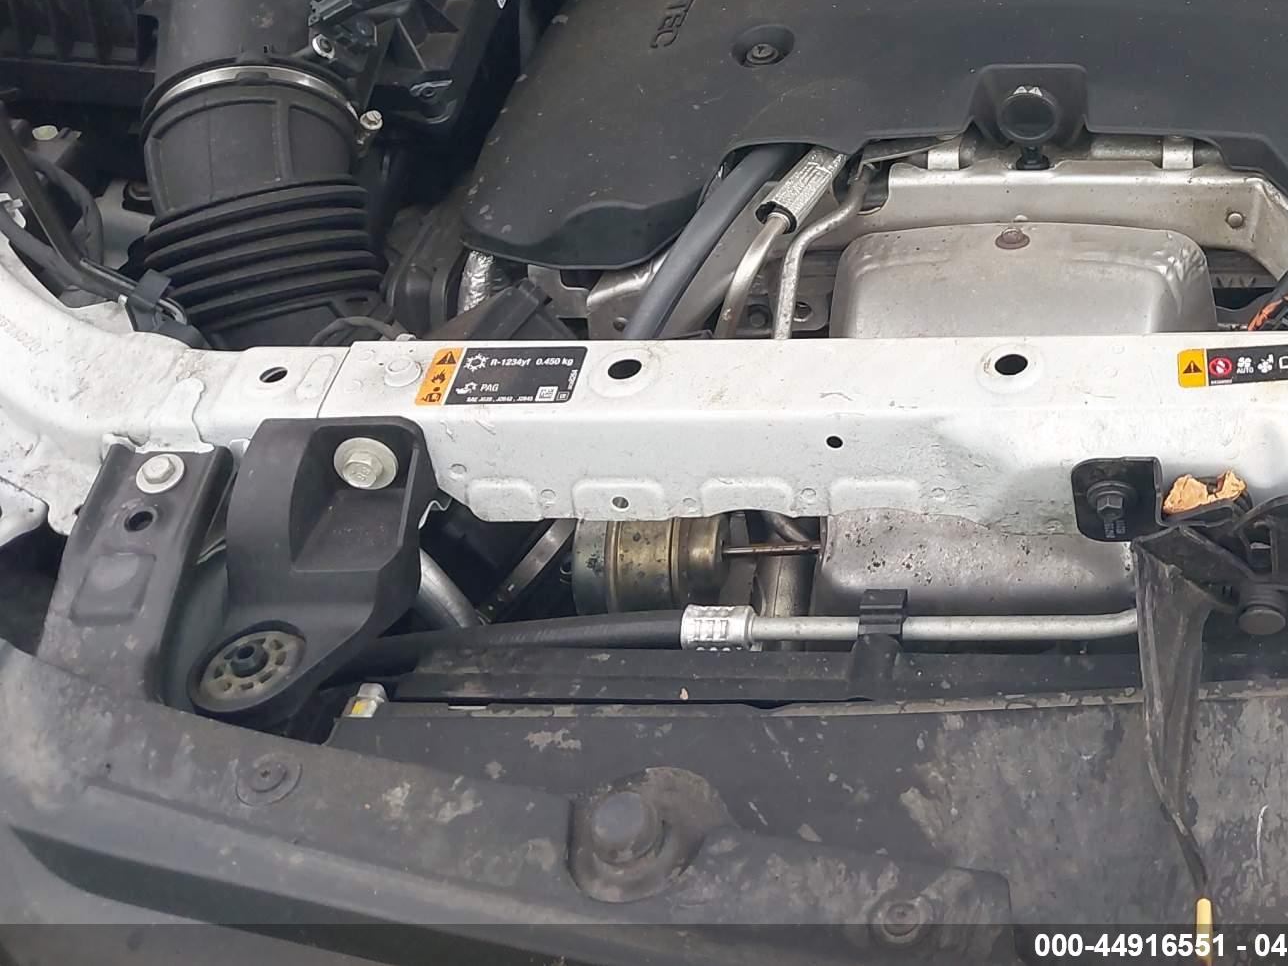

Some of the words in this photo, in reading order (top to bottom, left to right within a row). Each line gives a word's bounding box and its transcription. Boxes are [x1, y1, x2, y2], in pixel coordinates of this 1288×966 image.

[490, 358, 531, 367] R-1234yf
[535, 357, 561, 366] 0.450
[561, 357, 574, 367] kg
[1236, 366, 1254, 374] AUTO
[480, 383, 499, 392] PAG
